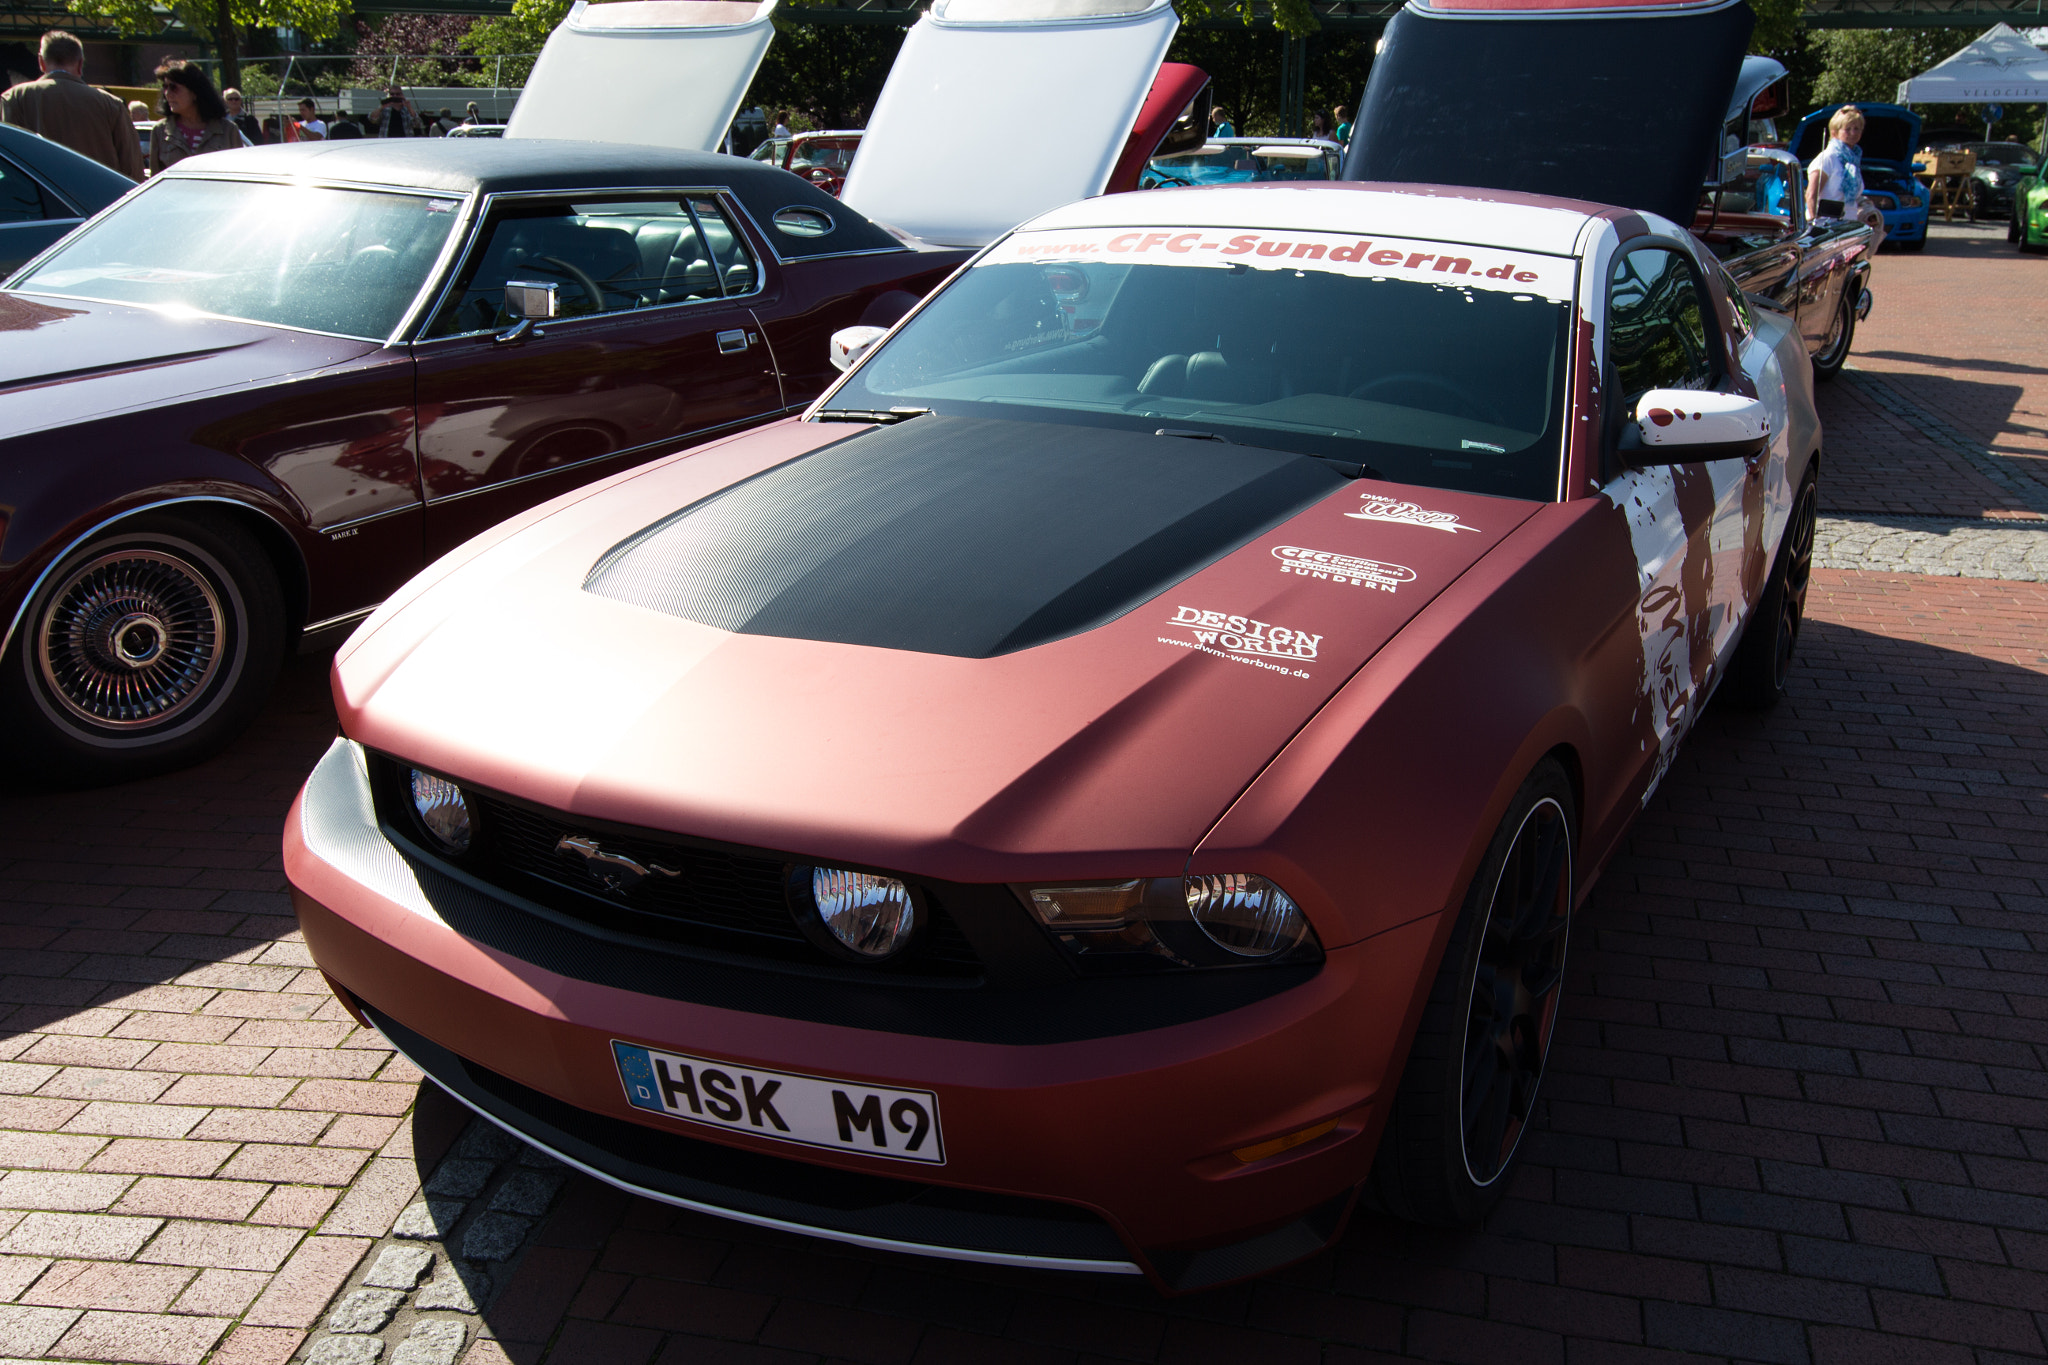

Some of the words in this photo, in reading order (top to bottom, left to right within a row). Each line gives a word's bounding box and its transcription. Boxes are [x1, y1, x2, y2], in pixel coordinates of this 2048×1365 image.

[1963, 88, 2040, 97] VELOCITY
[1018, 233, 1539, 283] www.CFC-Sundern.de
[331, 530, 351, 540] MARK
[1281, 548, 1331, 563] CFC
[1280, 566, 1397, 593] SUNDERN
[1171, 605, 1323, 649] DESIGN
[1157, 636, 1310, 679] www.dwm-werbung.de
[1192, 630, 1318, 658] WORLD
[636, 1085, 650, 1099] D
[655, 1059, 791, 1132] HSK
[832, 1090, 930, 1151] M9
